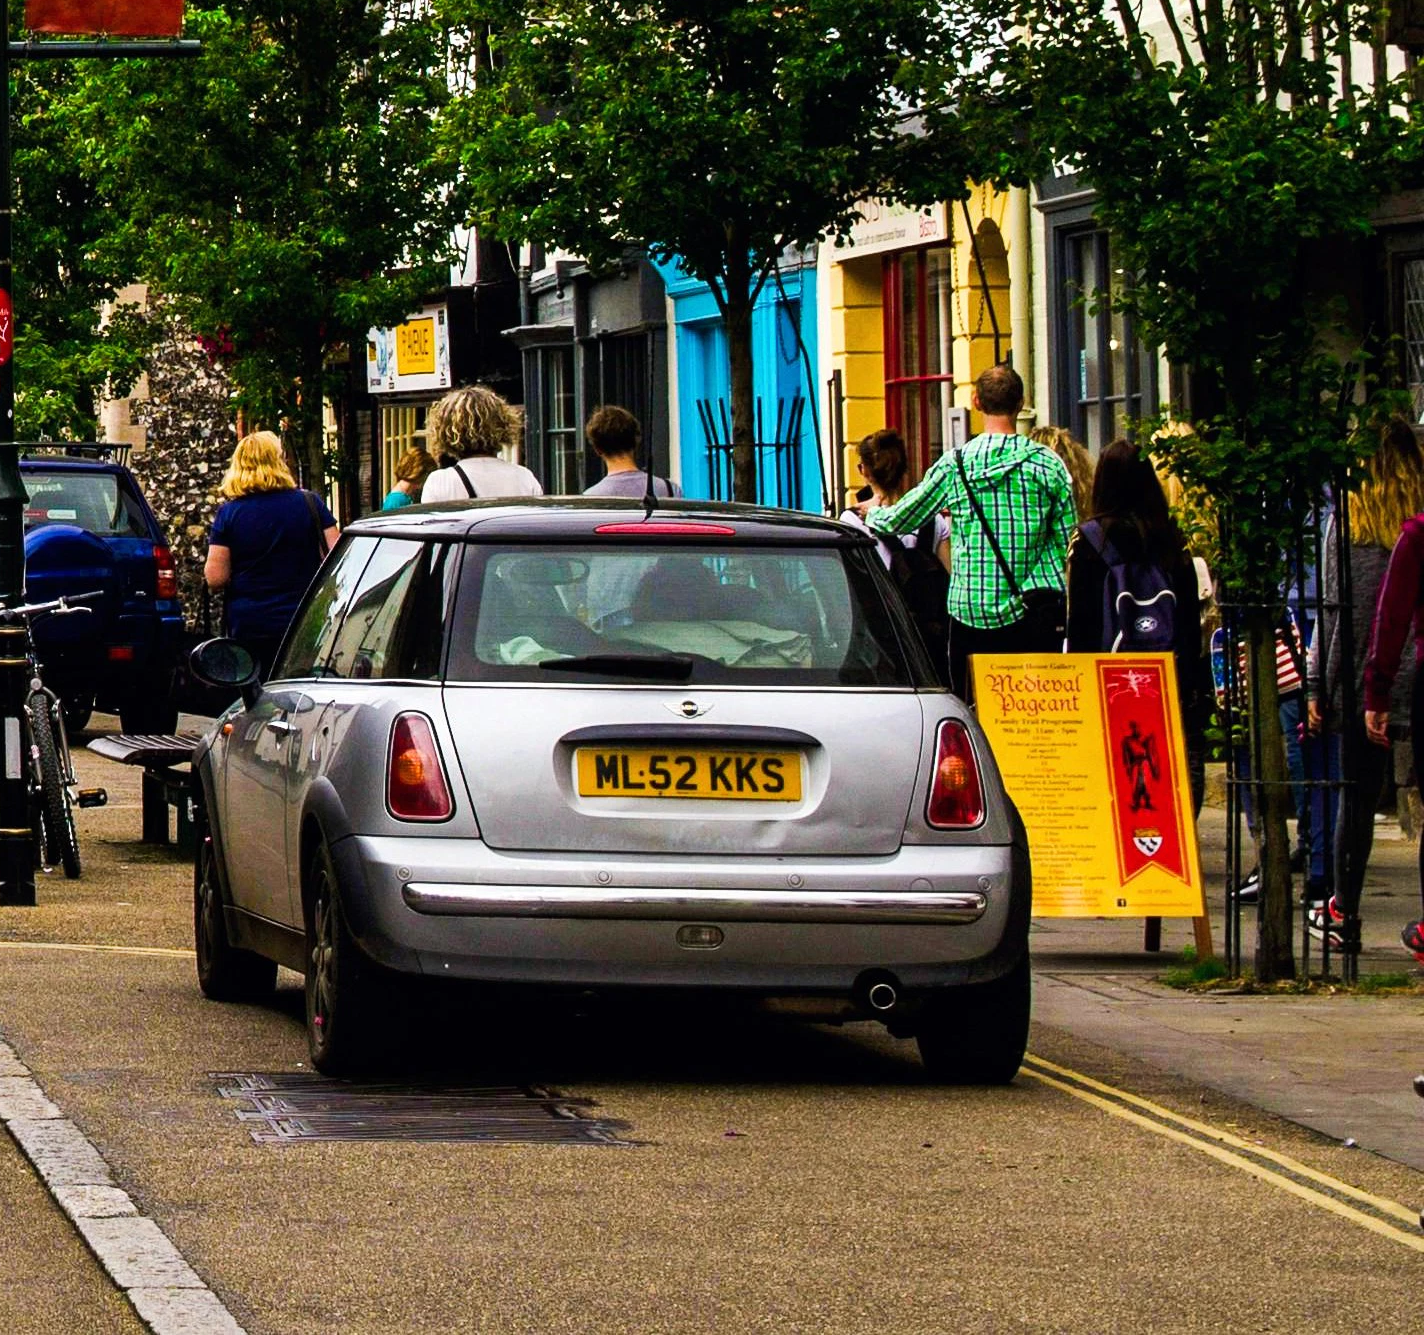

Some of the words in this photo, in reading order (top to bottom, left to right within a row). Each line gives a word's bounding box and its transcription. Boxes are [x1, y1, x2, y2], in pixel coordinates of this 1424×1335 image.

[984, 672, 1084, 693] Medieval
[994, 692, 1080, 717] Pageant
[594, 754, 698, 791] ML52
[708, 756, 785, 793] KKS
